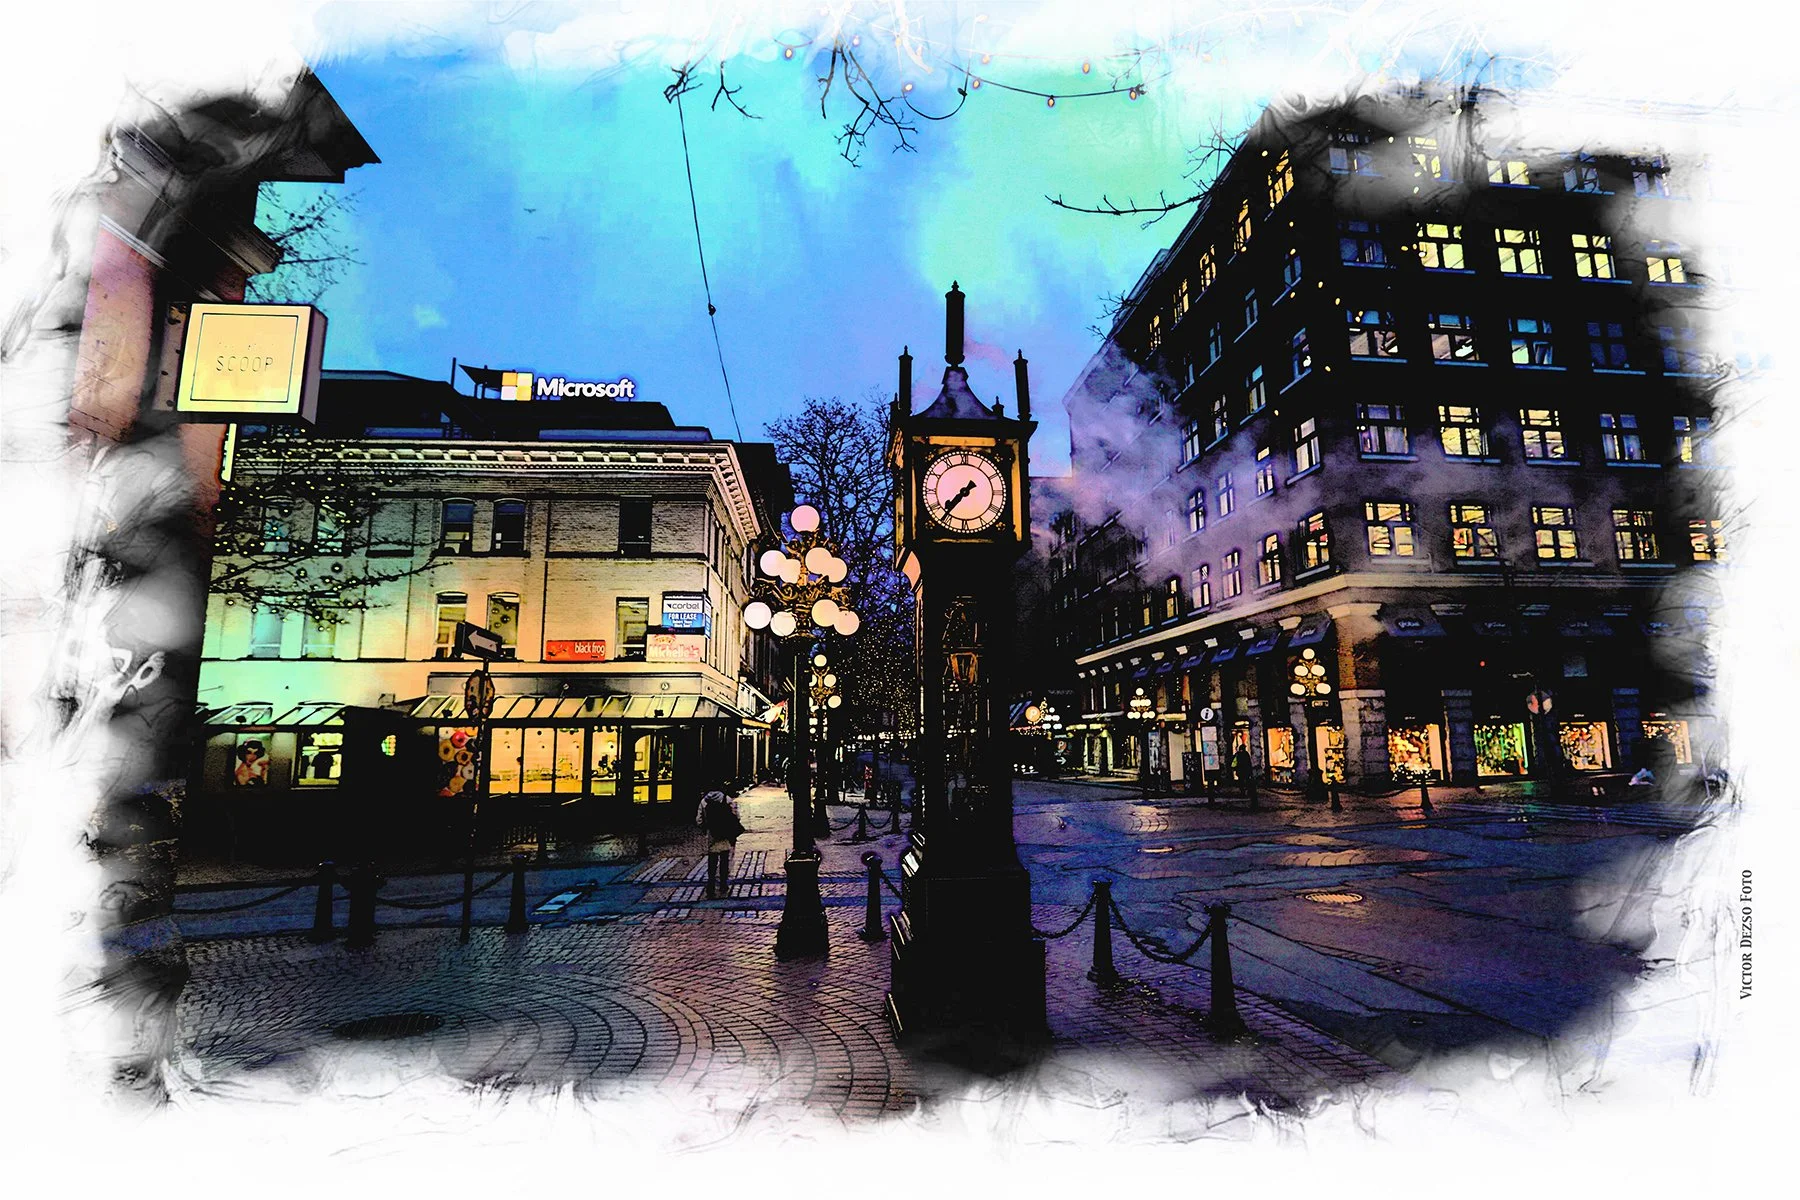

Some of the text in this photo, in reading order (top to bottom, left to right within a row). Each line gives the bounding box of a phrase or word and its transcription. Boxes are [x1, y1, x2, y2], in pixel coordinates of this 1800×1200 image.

[216, 355, 274, 372] SCOOP
[537, 377, 635, 398] Microsoft
[672, 602, 700, 610] corbel
[574, 641, 606, 657] black frog
